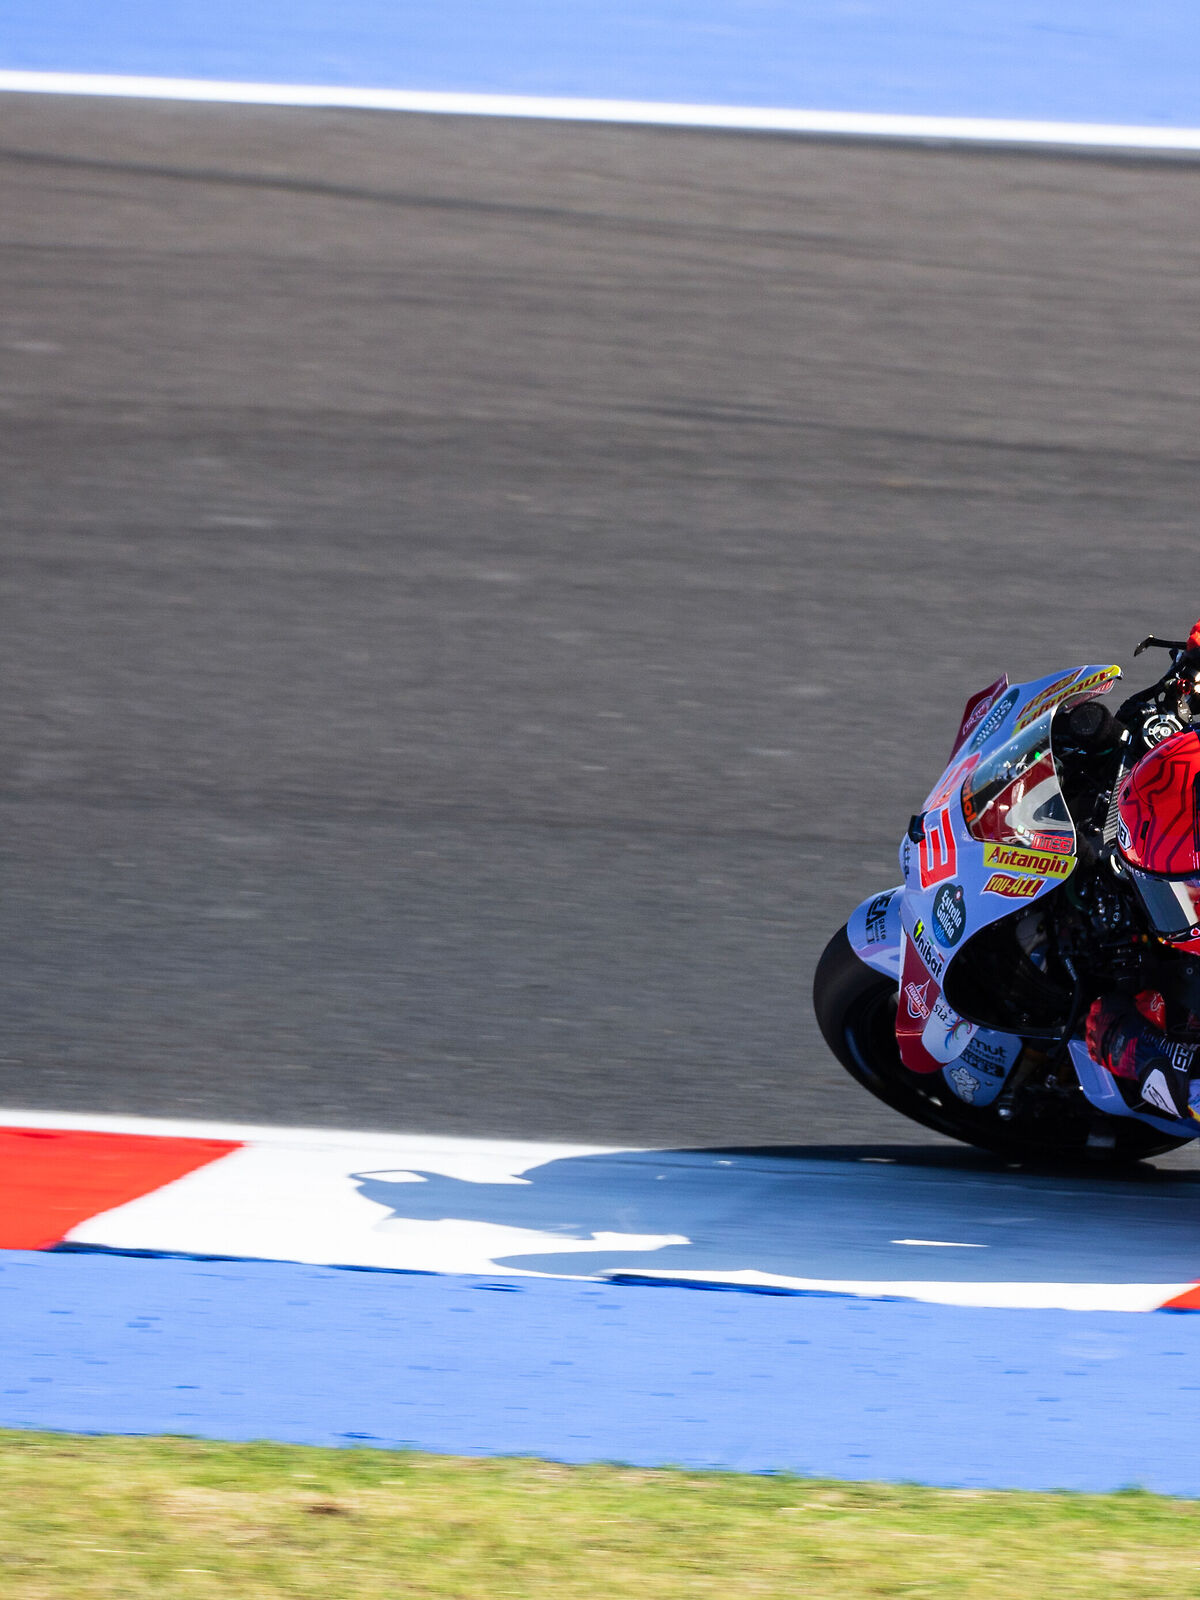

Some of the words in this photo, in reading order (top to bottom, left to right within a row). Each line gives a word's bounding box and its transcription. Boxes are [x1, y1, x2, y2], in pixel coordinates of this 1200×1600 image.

[987, 847, 1069, 874] Antangin
[987, 875, 1040, 896] YOU-ALL
[936, 905, 955, 939] Galicia
[941, 889, 962, 928] Estrella
